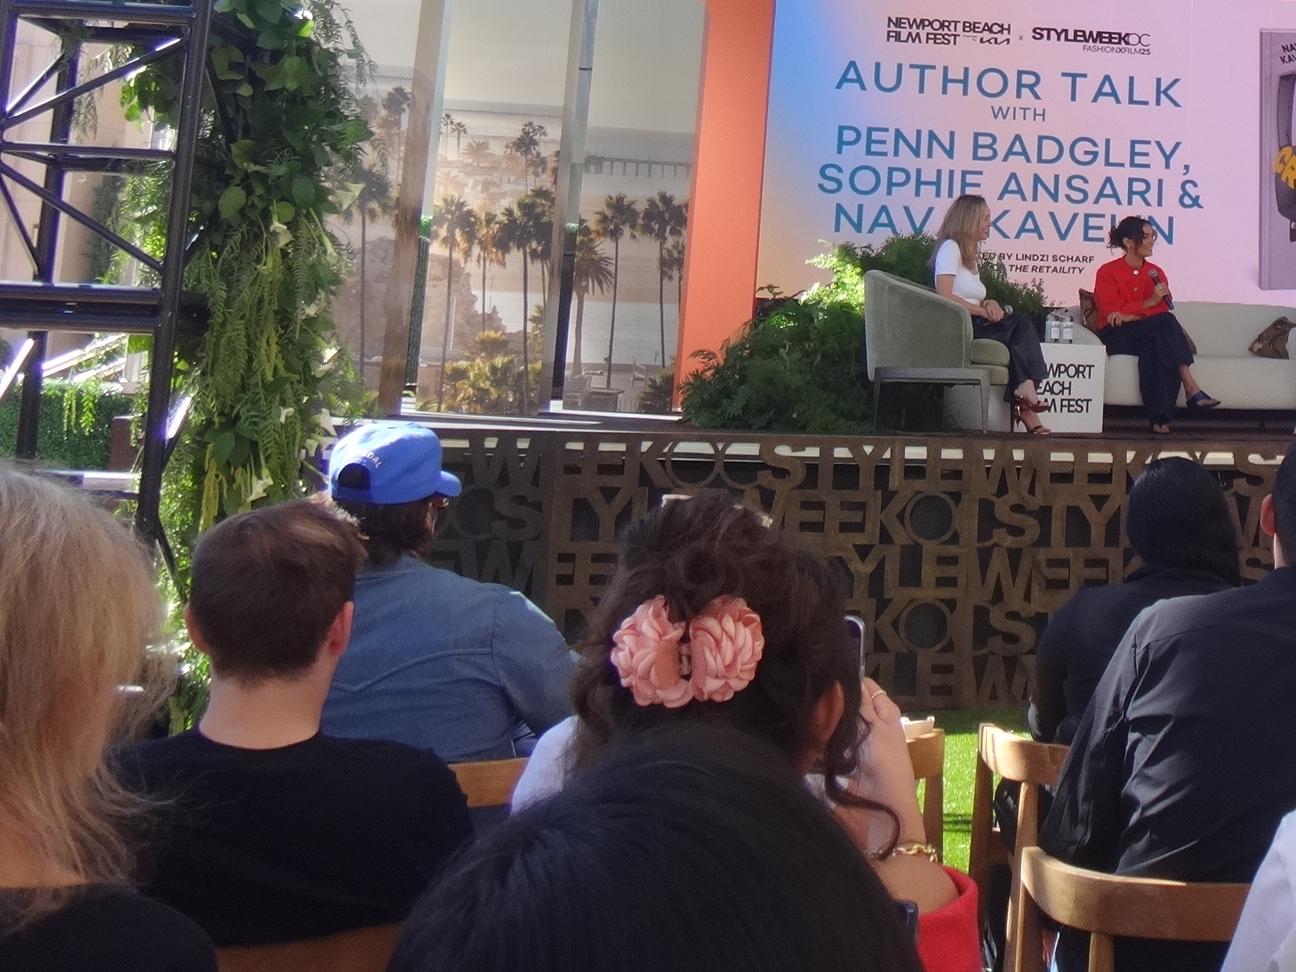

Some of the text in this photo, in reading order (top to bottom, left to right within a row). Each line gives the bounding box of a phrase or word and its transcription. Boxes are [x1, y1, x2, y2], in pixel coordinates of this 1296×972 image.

[887, 16, 1011, 35] NEWPORT BEACH
[886, 30, 922, 44] FILM
[925, 33, 960, 46] FEST
[1031, 27, 1151, 47] STYLEWEEKOC
[1082, 44, 1151, 56] FASHIONXFILM25
[835, 60, 1183, 108] AUTHOR TALK
[990, 105, 1046, 122] WITH
[836, 125, 1191, 176] PENN BADGLEY,
[817, 163, 1204, 209] SOPHIE ANSARI &
[834, 203, 1175, 246] NAV KAVEN
[1000, 253, 1013, 261] BY
[1016, 253, 1049, 262] LINDZI
[1052, 254, 1095, 263] SCHARF
[1009, 264, 1028, 273] THE
[1031, 265, 1085, 274] RETAILITY
[1047, 363, 1095, 379] WPORT
[1060, 399, 1092, 413] FEST
